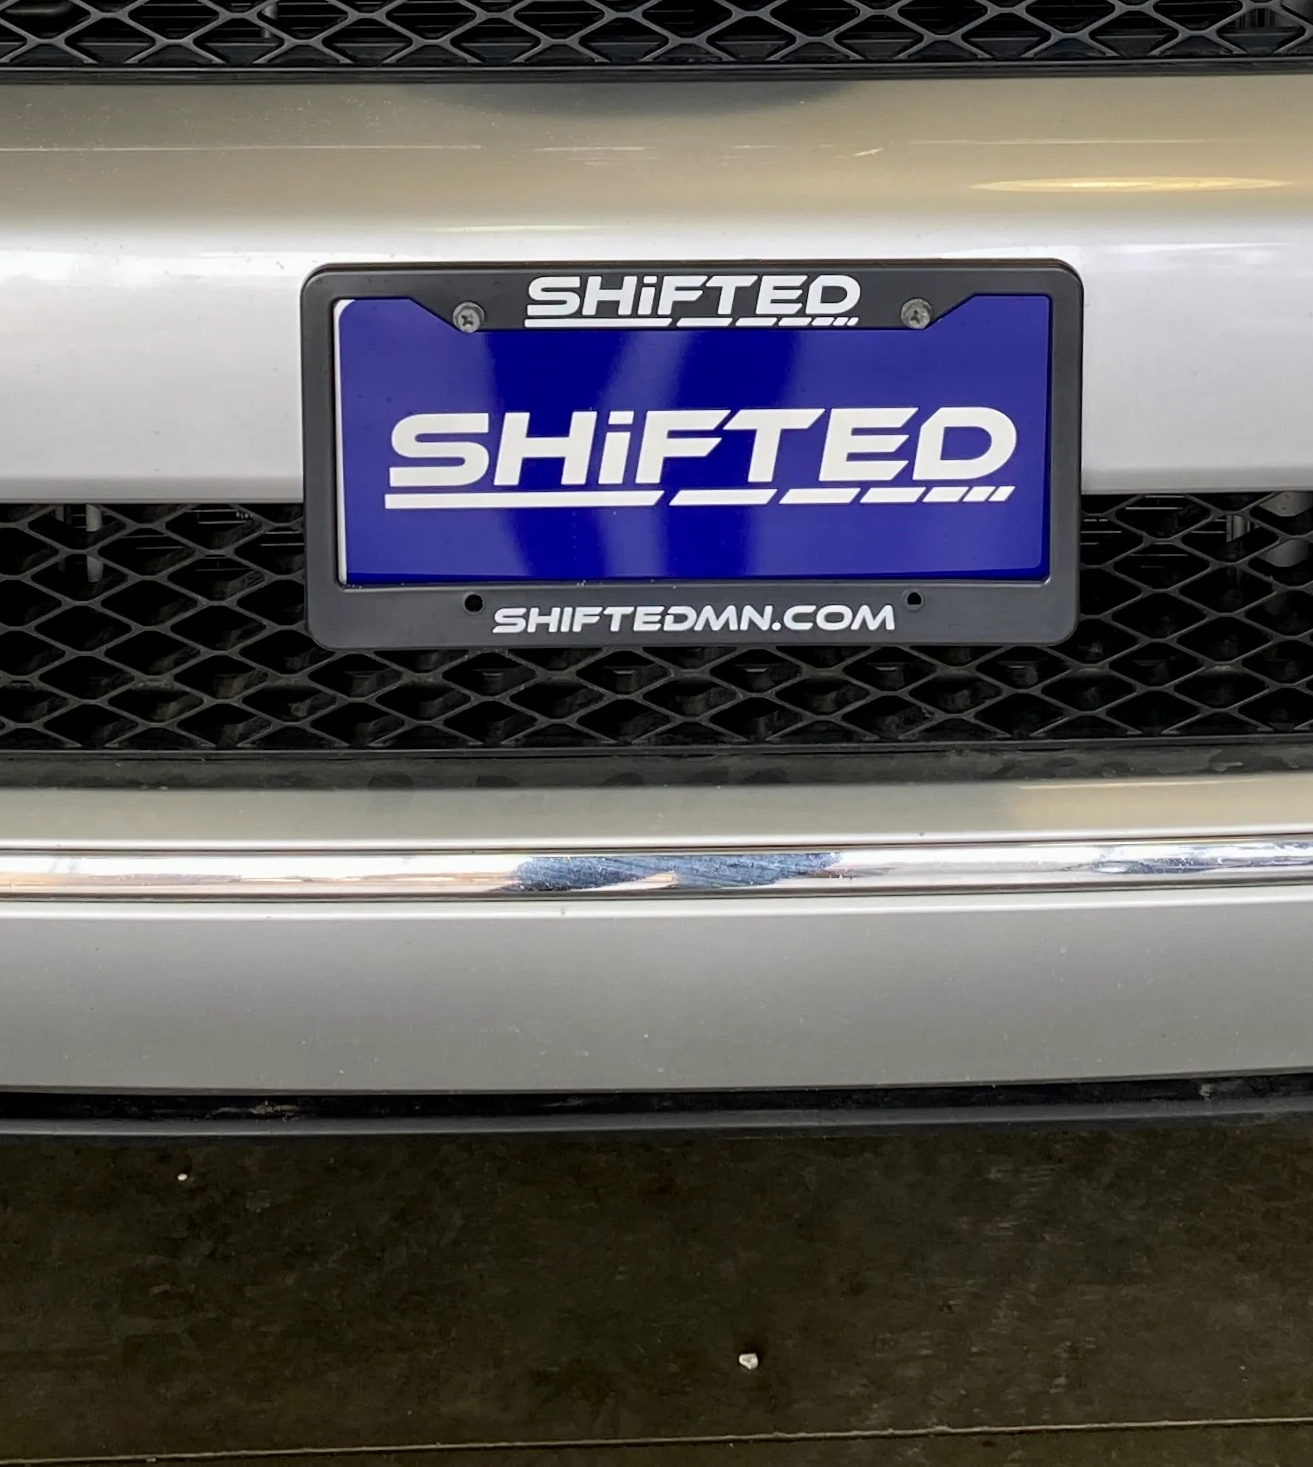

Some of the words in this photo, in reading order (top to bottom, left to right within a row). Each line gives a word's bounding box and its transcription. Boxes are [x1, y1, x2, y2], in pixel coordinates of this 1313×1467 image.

[527, 275, 861, 316] SHiFTED
[389, 407, 1018, 487] SHiFTED
[492, 603, 896, 634] SHIFTEDMN.COM
